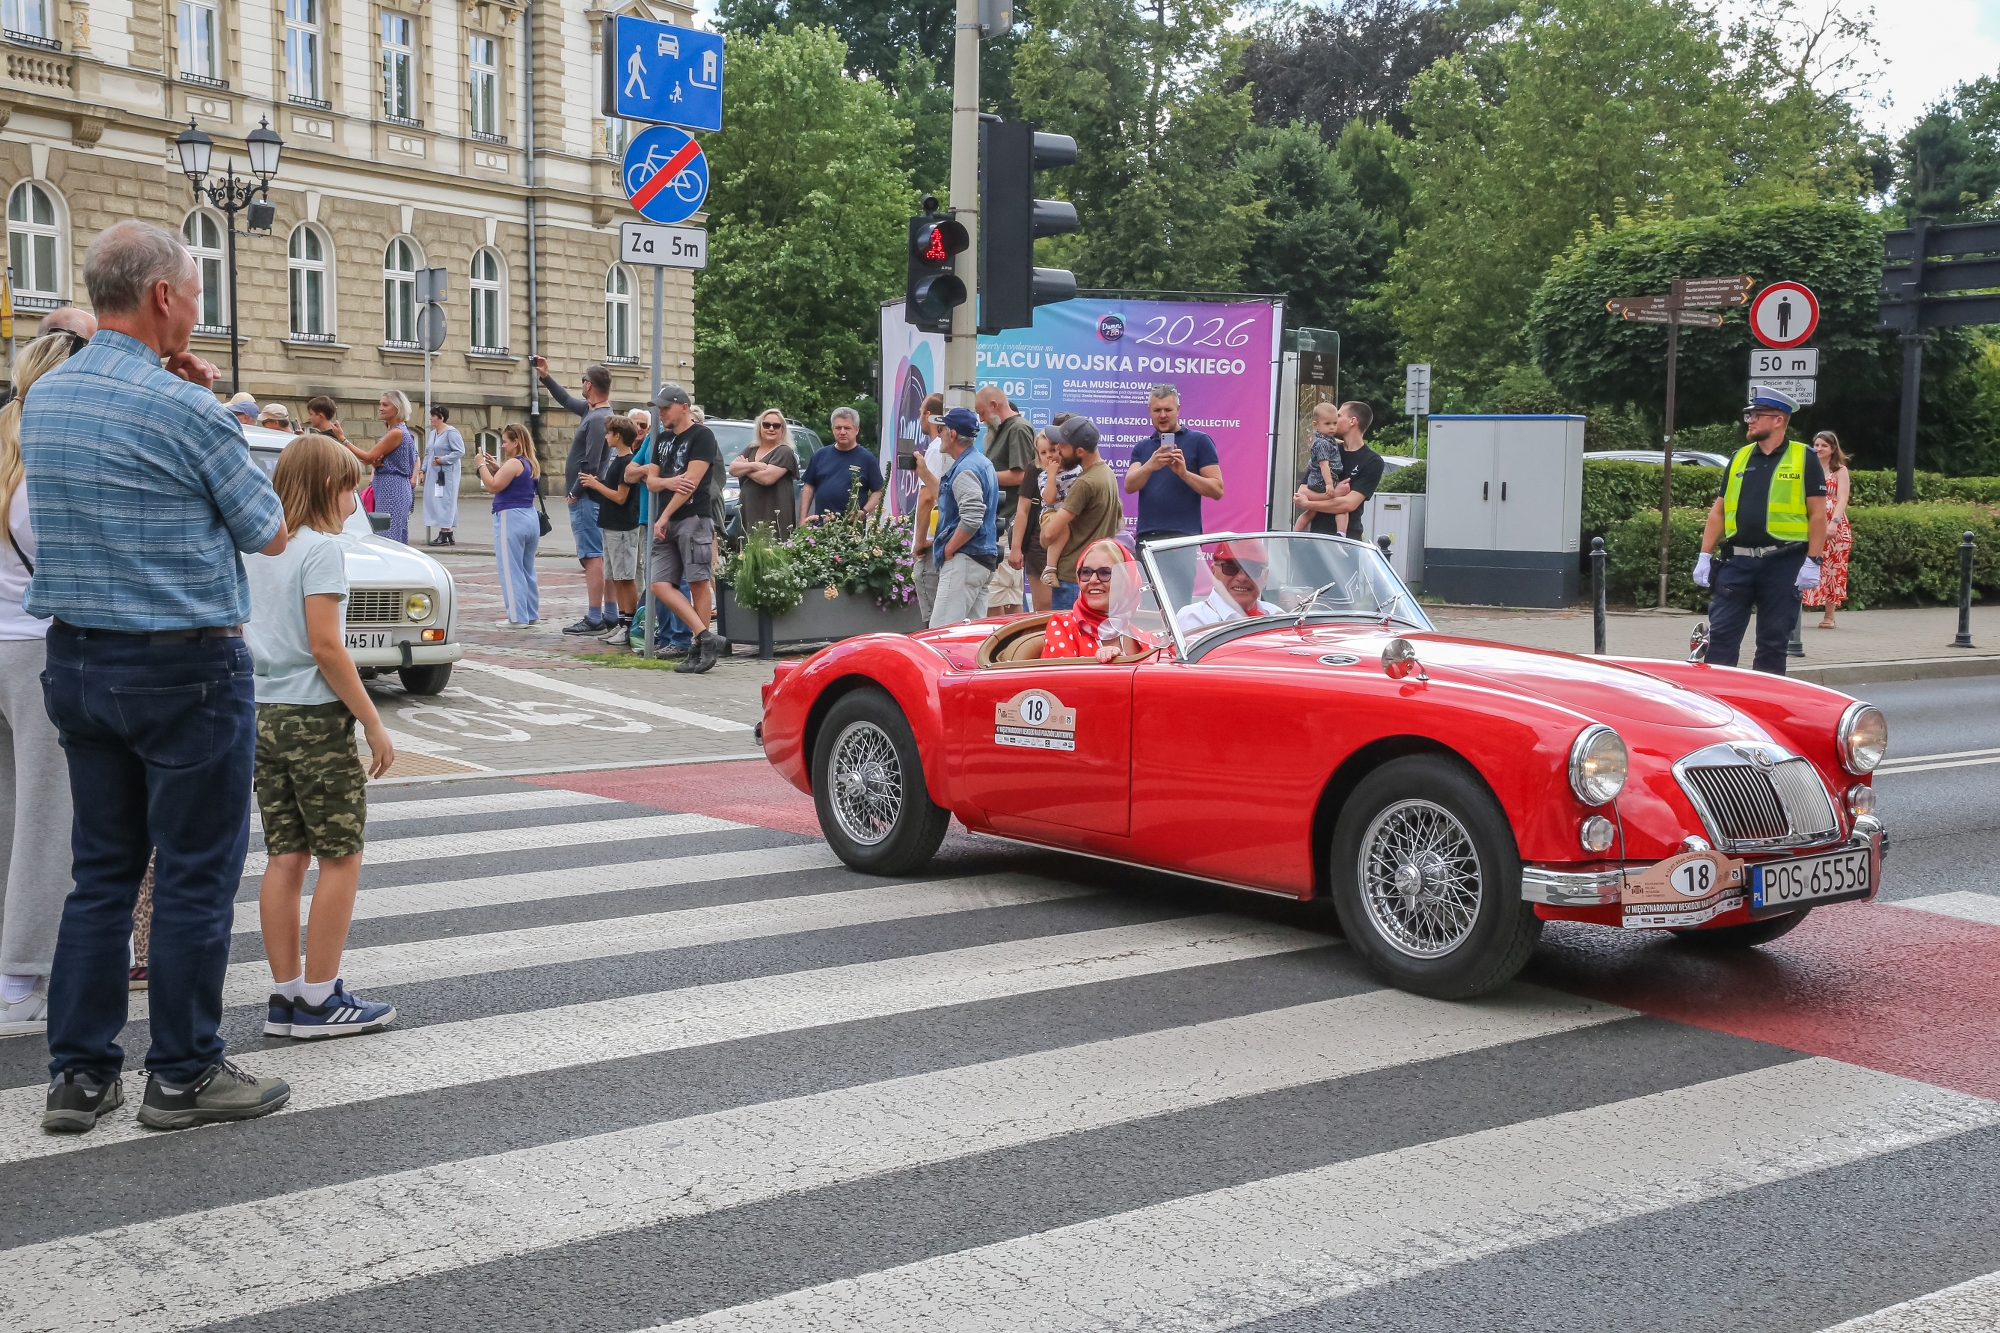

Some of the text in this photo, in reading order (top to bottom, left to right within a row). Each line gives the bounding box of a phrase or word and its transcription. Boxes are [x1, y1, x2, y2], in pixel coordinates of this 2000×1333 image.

[631, 232, 699, 258] Za 5m
[1102, 322, 1122, 331] Dumni
[1136, 315, 1256, 346] 2026
[976, 352, 1246, 374] PLACU WOJSKA POLSKIEGO
[1760, 356, 1806, 371] 50 m
[1090, 381, 1152, 390] MUSICALOWA
[1096, 416, 1148, 425] SIEMASZKO
[1188, 419, 1240, 427] COLLECTIVE
[372, 634, 385, 648] IV
[1028, 700, 1043, 721] 18
[1683, 864, 1709, 892] 18
[1765, 854, 1866, 902] POS 65556
[1753, 892, 1762, 901] PL
[1625, 906, 1631, 914] 47
[1632, 904, 1678, 914] MIĘDZYNARODOWY
